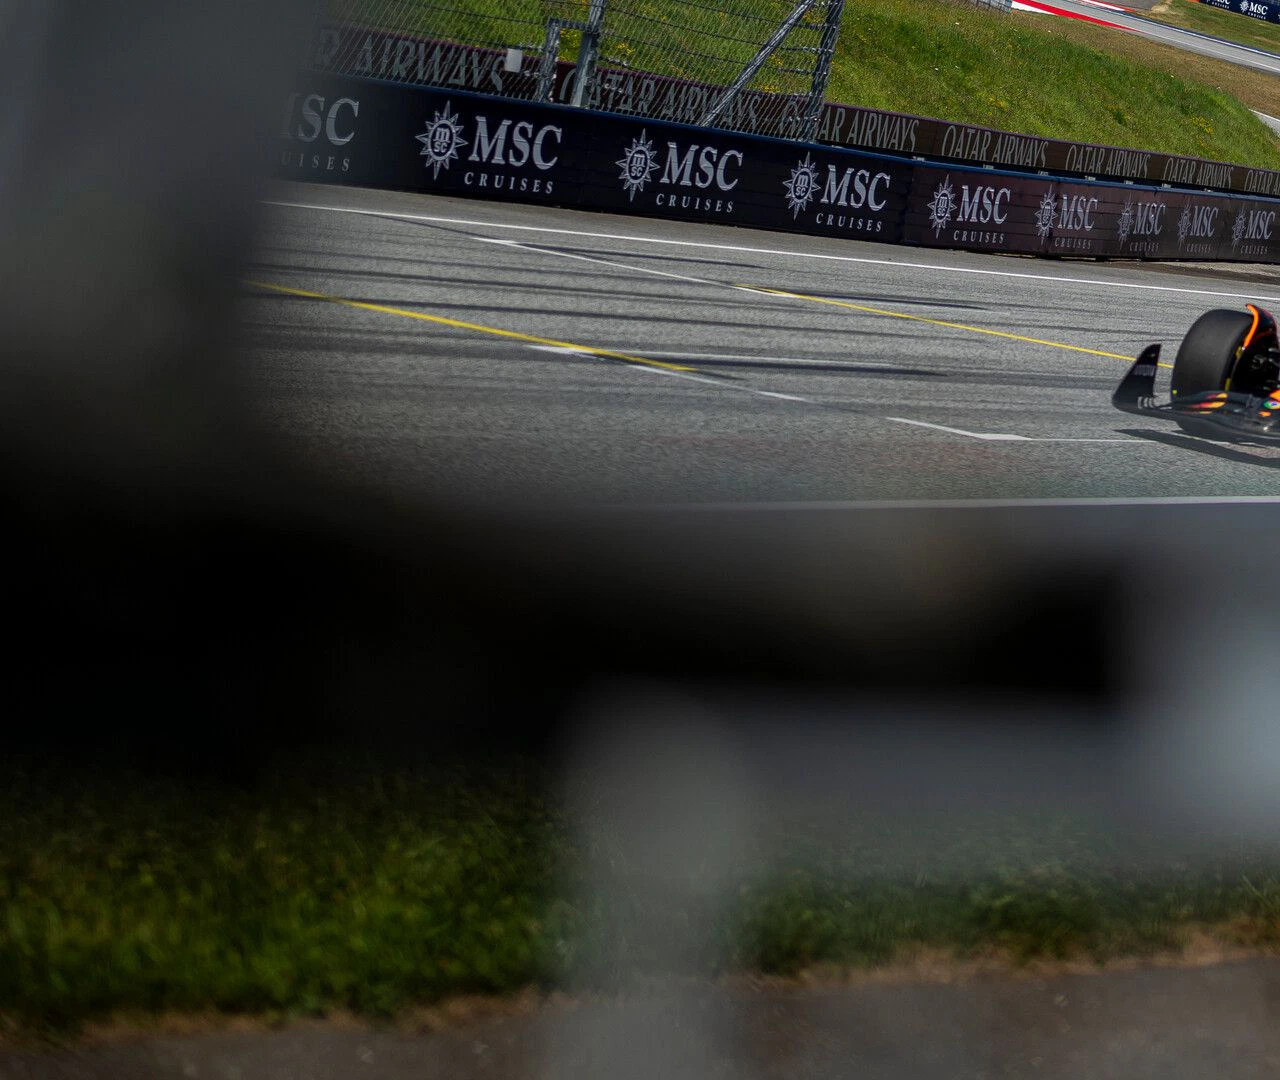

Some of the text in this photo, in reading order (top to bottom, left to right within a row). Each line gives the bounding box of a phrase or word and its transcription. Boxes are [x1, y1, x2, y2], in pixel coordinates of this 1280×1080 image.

[1249, 2, 1268, 15] MSC
[469, 117, 562, 169] MSC
[846, 110, 920, 152] AIRWAYS
[942, 125, 1048, 168] QATAR AIRWAYS
[660, 142, 743, 191] MSC
[1066, 145, 1151, 178] QATAR AIRWAYS
[1196, 162, 1234, 189] AIRWAYS
[464, 172, 553, 194] CRUISES
[820, 165, 890, 211] MSC
[656, 193, 733, 213] CRUISES
[957, 184, 1010, 225] MSC
[1057, 195, 1098, 232] MSC
[1133, 203, 1166, 236] MSC
[816, 213, 881, 232] CRUISES
[953, 230, 1004, 244] CRUISES
[1190, 205, 1218, 238] MSC
[1245, 210, 1275, 240] MSC
